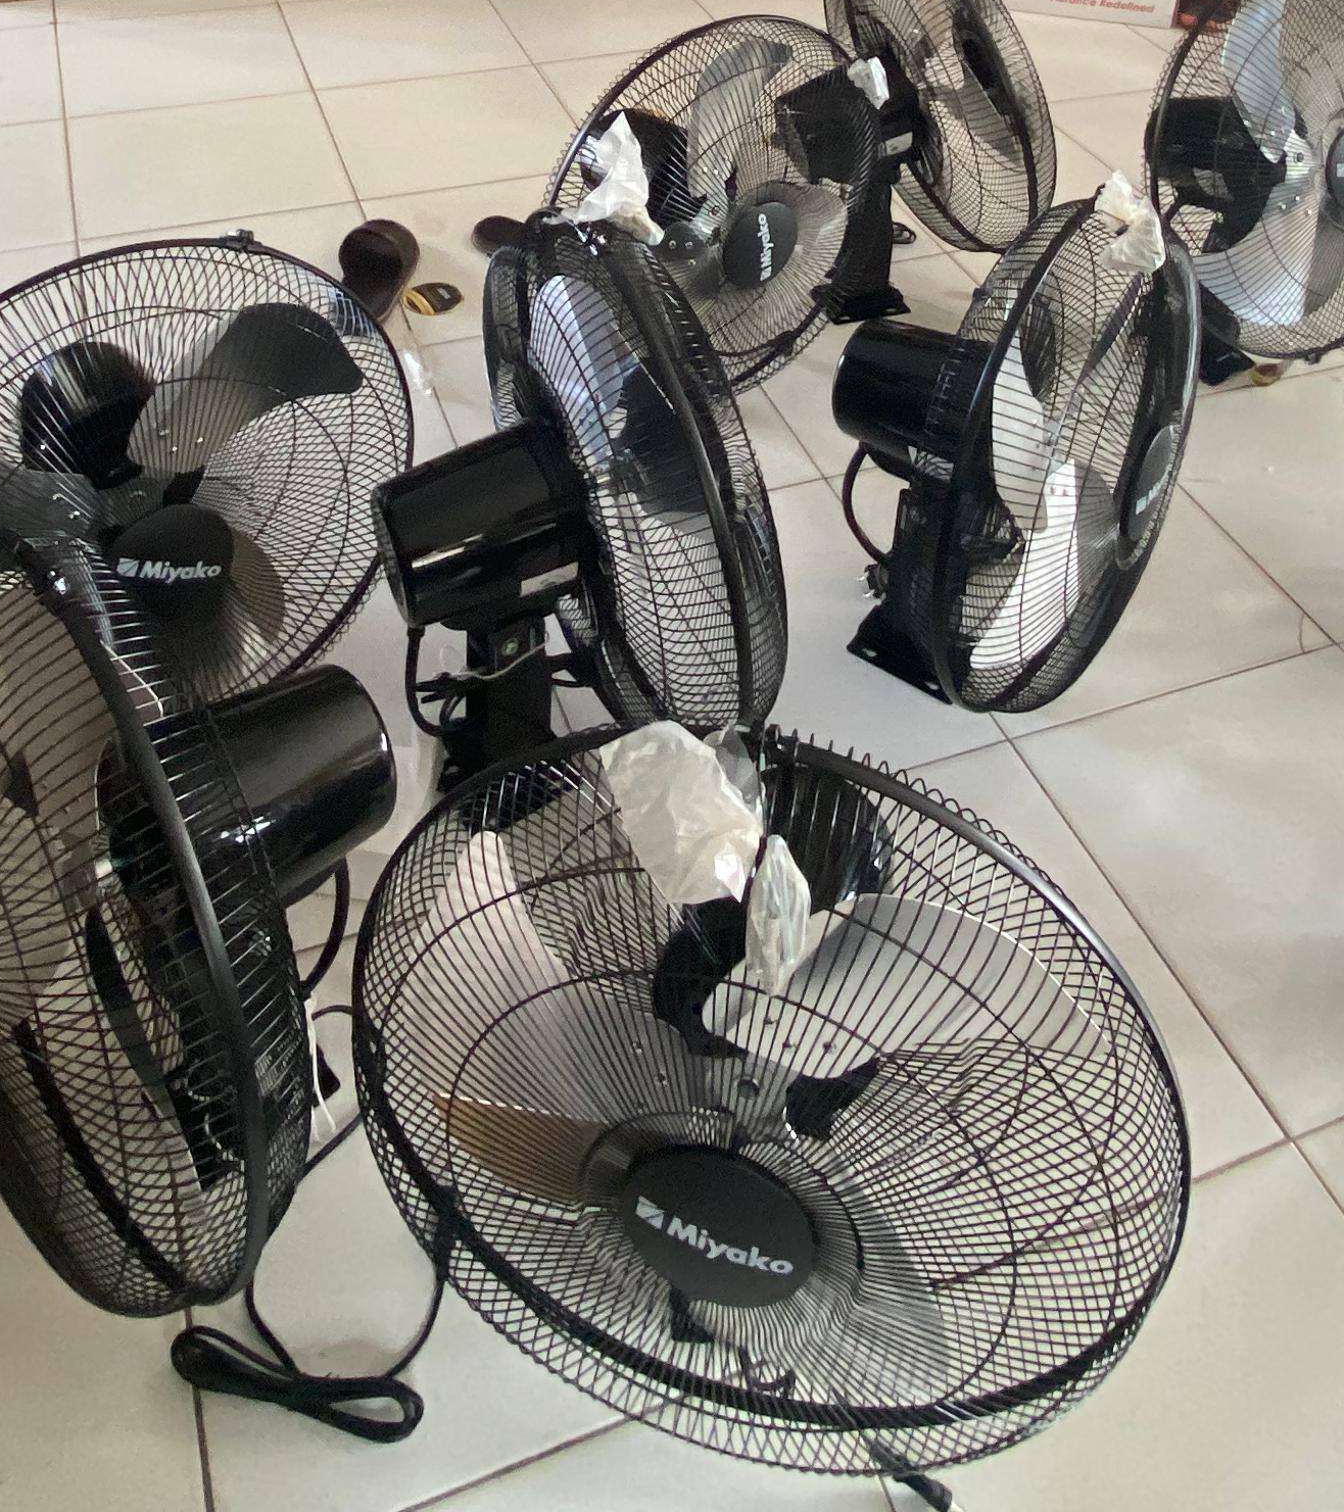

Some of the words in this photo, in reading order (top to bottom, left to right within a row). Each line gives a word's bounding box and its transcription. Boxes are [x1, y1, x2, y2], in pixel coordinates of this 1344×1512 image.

[1099, 0, 1155, 13] Redefined
[757, 213, 775, 268] Miyako
[139, 561, 222, 584] Miyako
[666, 1215, 794, 1275] Miyako
